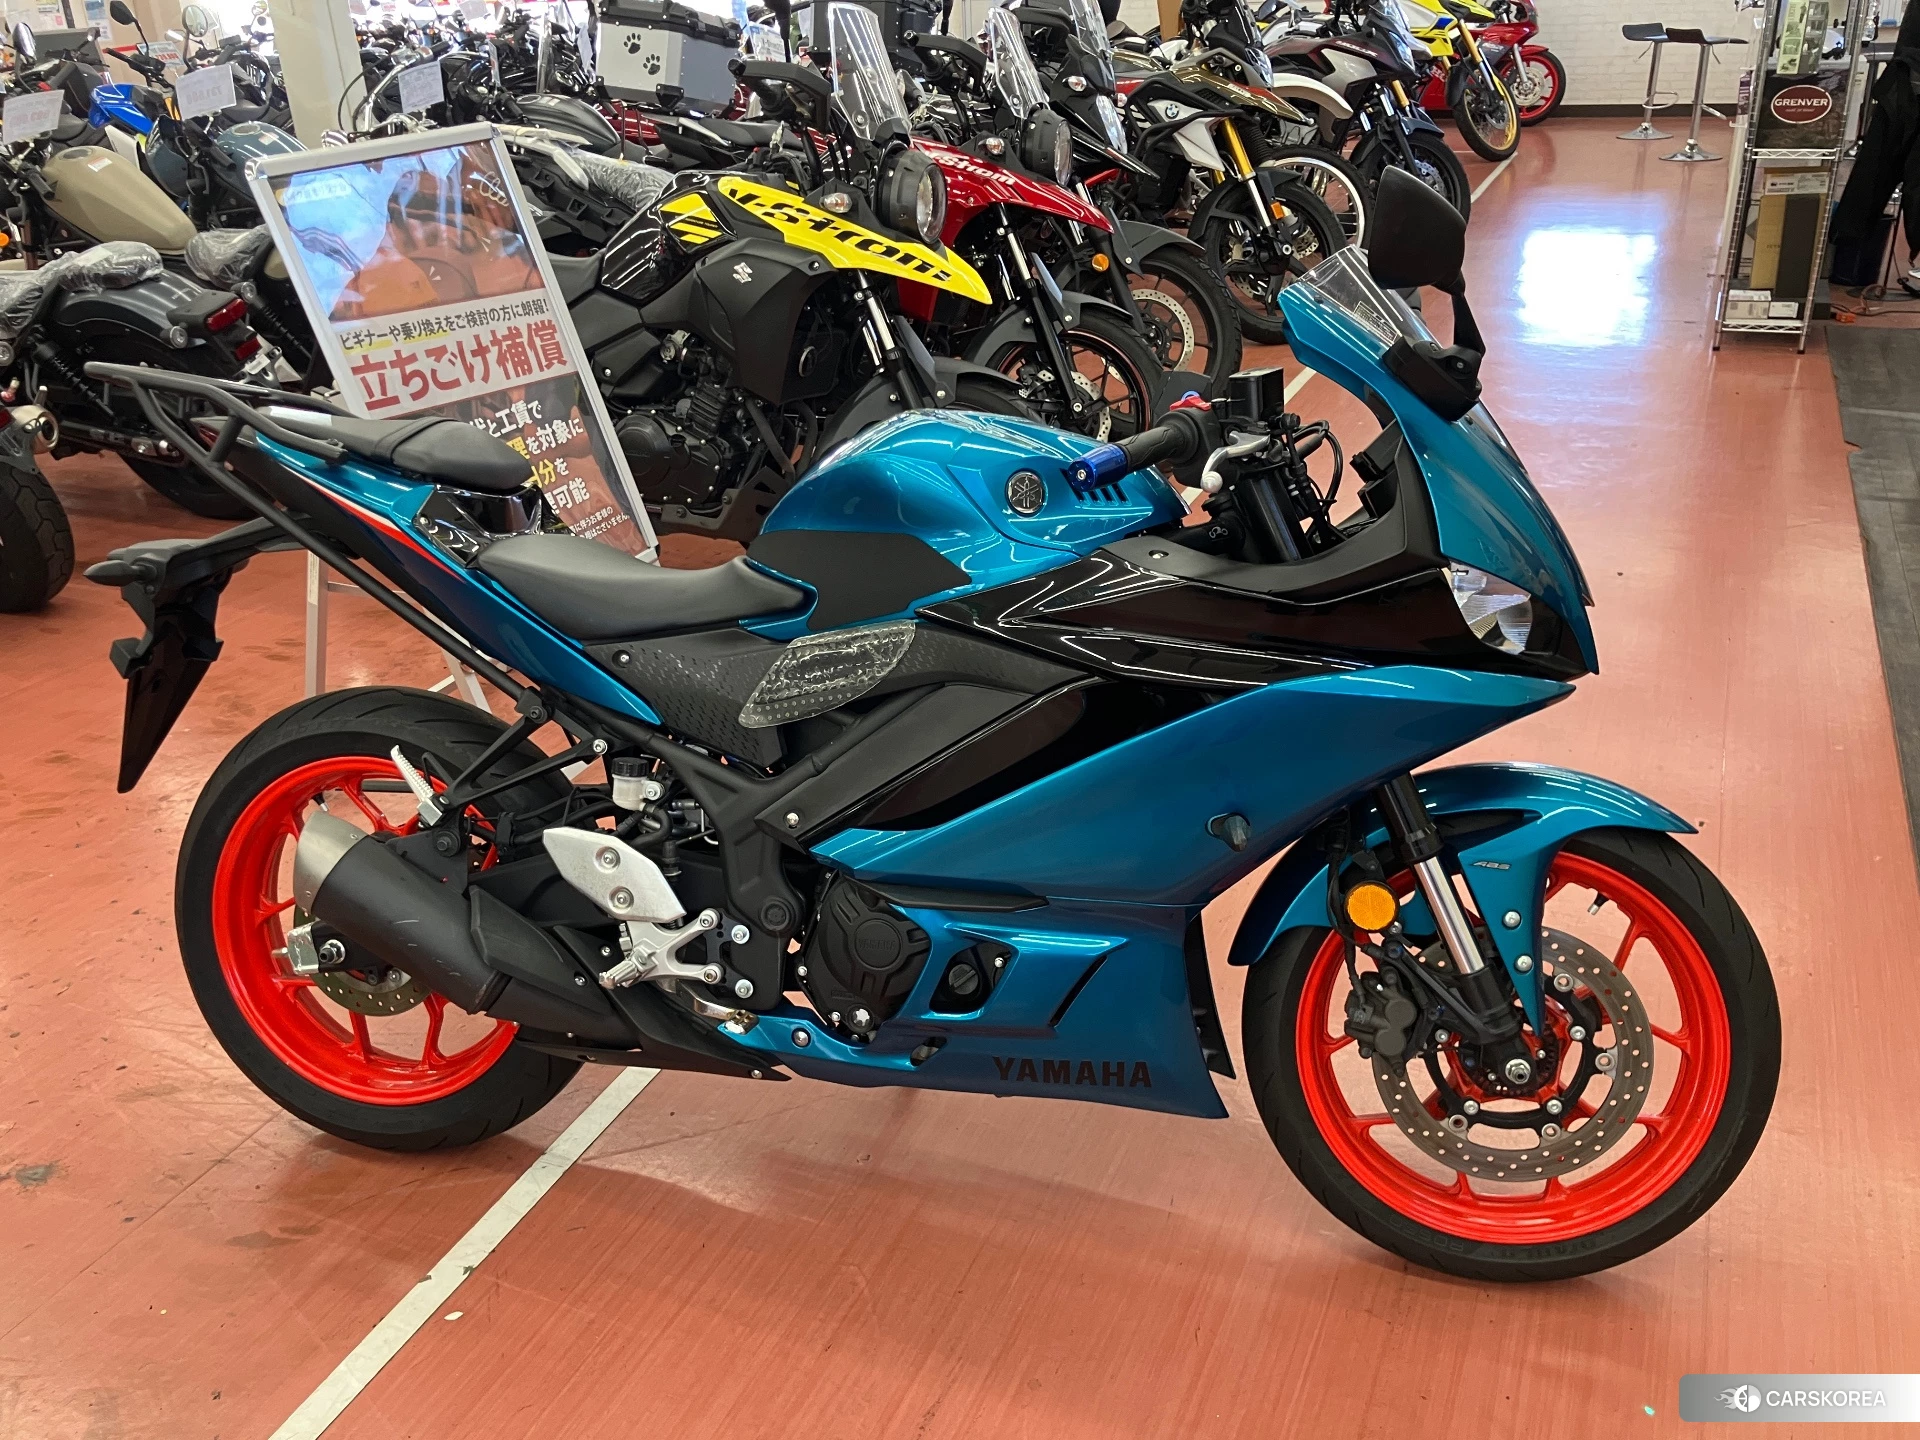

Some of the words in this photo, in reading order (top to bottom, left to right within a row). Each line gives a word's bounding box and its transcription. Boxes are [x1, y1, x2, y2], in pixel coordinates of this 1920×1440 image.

[1774, 98, 1828, 107] GRENVER
[728, 188, 952, 282] V-Strom
[340, 298, 549, 351] ビギナーや乗り換えをご検討の方に朗報!
[351, 319, 568, 411] 立ちごけ補償
[569, 506, 614, 534] に伴うお客様の
[1472, 861, 1511, 870] ABS
[992, 1056, 1152, 1088] YAMAHA
